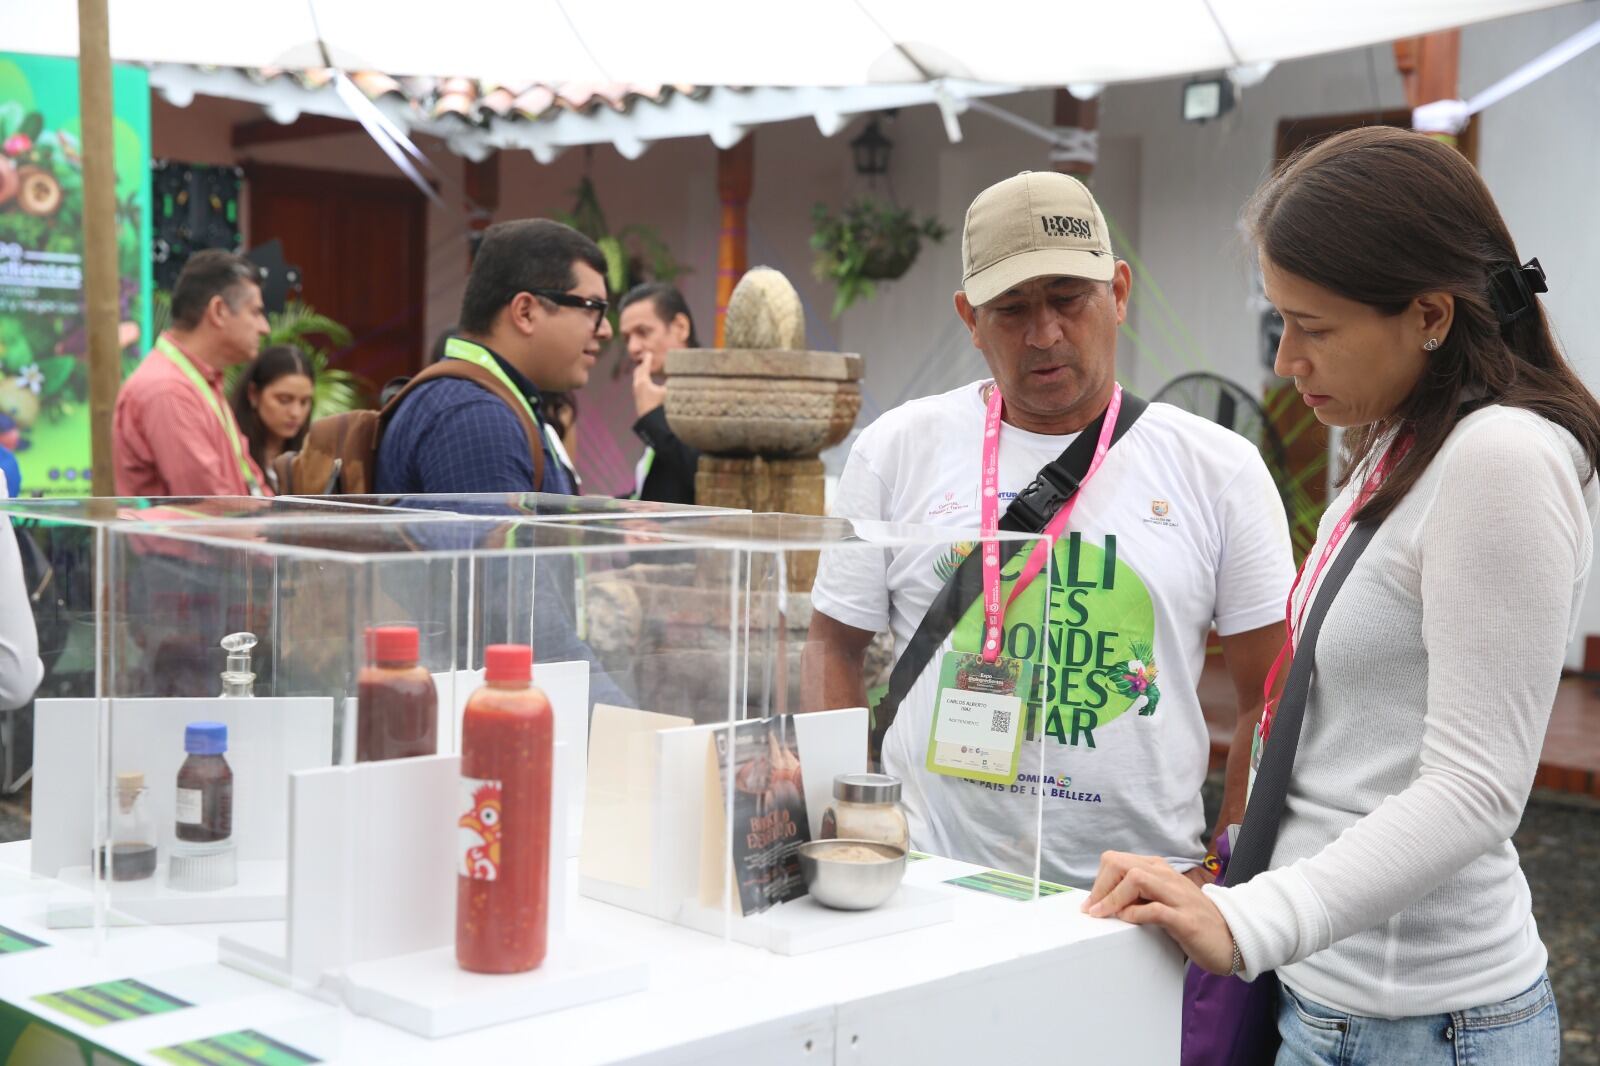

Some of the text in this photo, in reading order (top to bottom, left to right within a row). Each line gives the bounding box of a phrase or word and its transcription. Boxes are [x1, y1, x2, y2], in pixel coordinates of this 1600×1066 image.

[1041, 215, 1092, 237] BOSS
[1043, 586, 1089, 627] ES
[1030, 663, 1108, 709] BES
[1026, 701, 1097, 749] TAR
[1010, 784, 1026, 794] DE
[1051, 788, 1102, 803] BELLEZA
